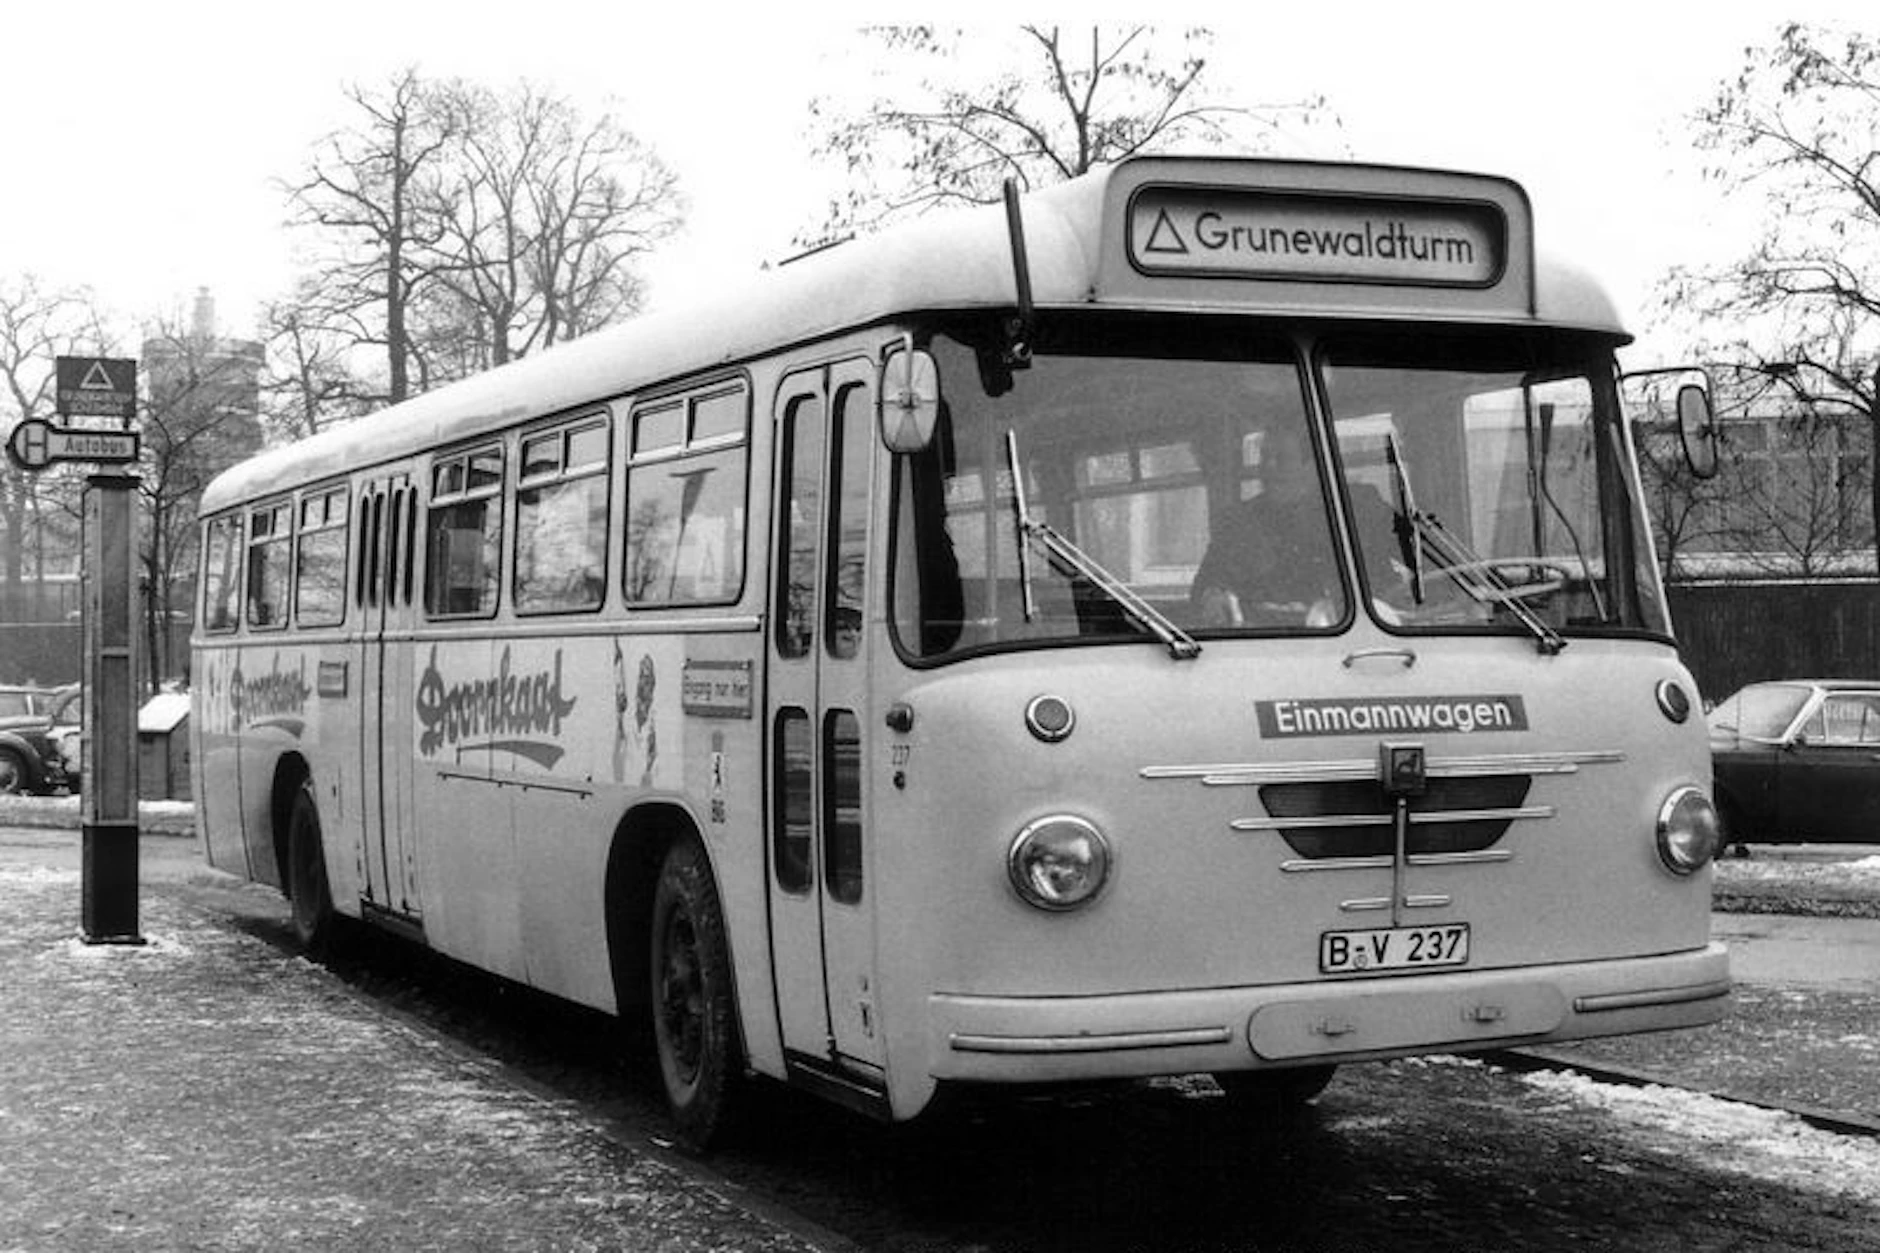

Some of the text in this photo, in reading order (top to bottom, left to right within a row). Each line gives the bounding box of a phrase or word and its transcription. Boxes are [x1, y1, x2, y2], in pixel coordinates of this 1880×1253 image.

[1194, 210, 1474, 264] Grunewaldturm
[24, 427, 128, 463] H Autobus
[1274, 701, 1513, 733] Einmannwagen
[1407, 928, 1462, 962] 237
